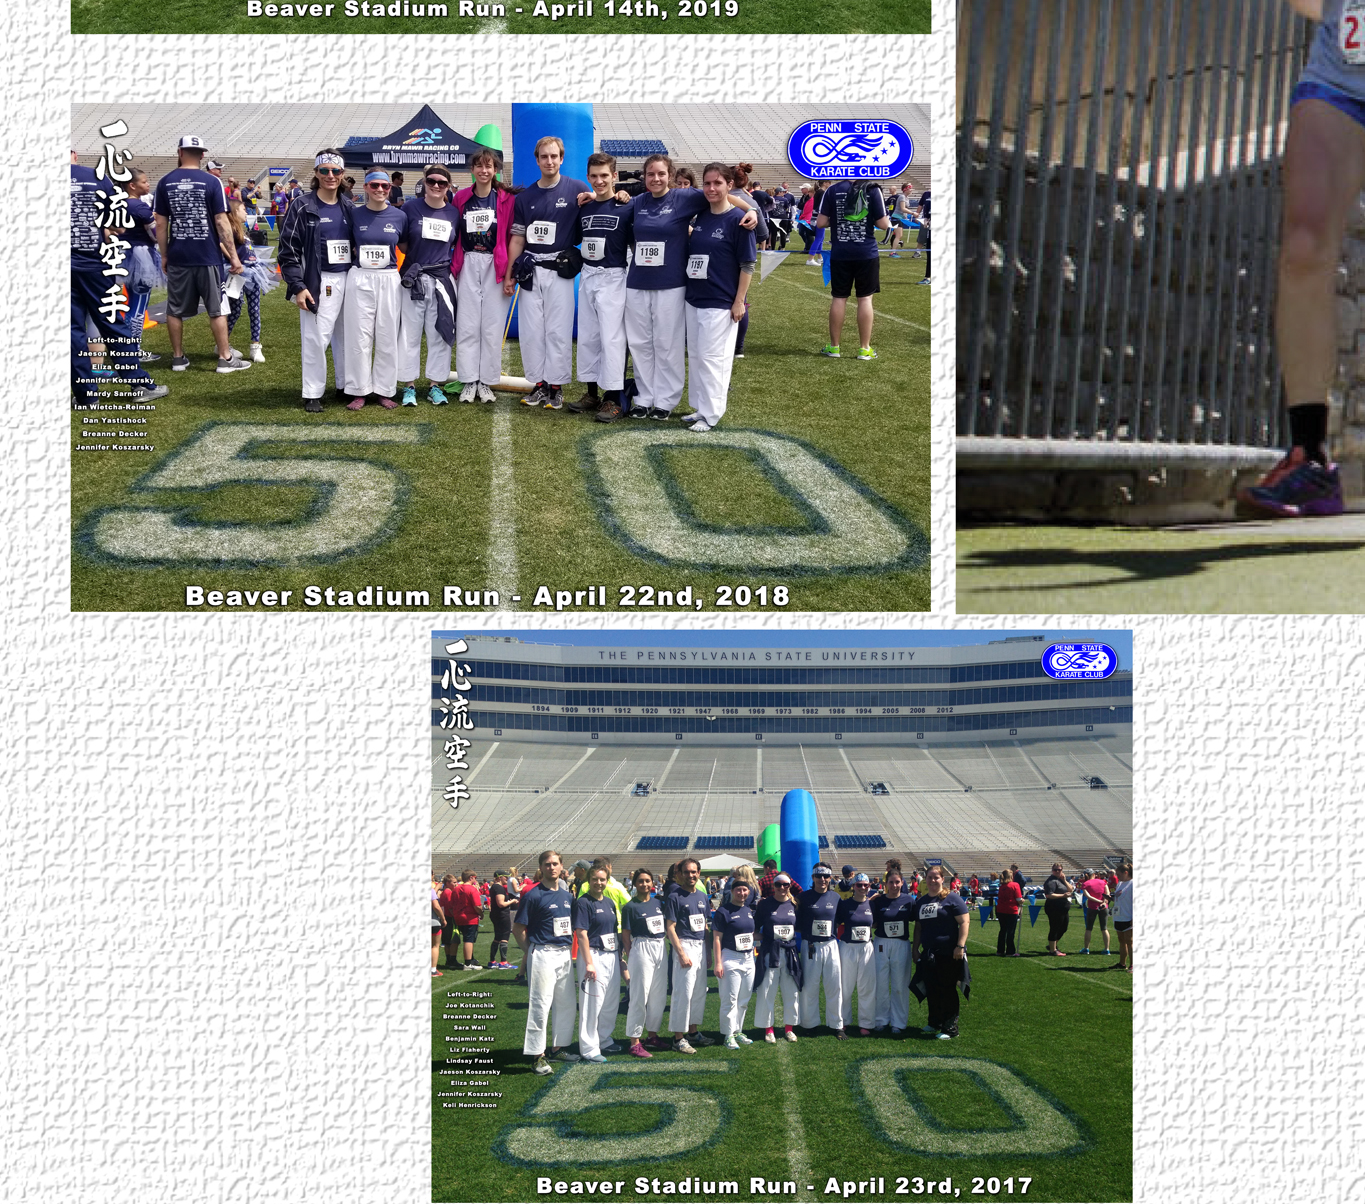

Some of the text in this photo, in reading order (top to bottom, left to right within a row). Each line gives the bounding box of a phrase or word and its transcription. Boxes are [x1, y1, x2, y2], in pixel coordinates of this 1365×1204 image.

[365, 250, 385, 260] 1194
[640, 247, 659, 257] 1198
[598, 651, 916, 661] THE PENNSYLVANIA STATE UNIVERSITY
